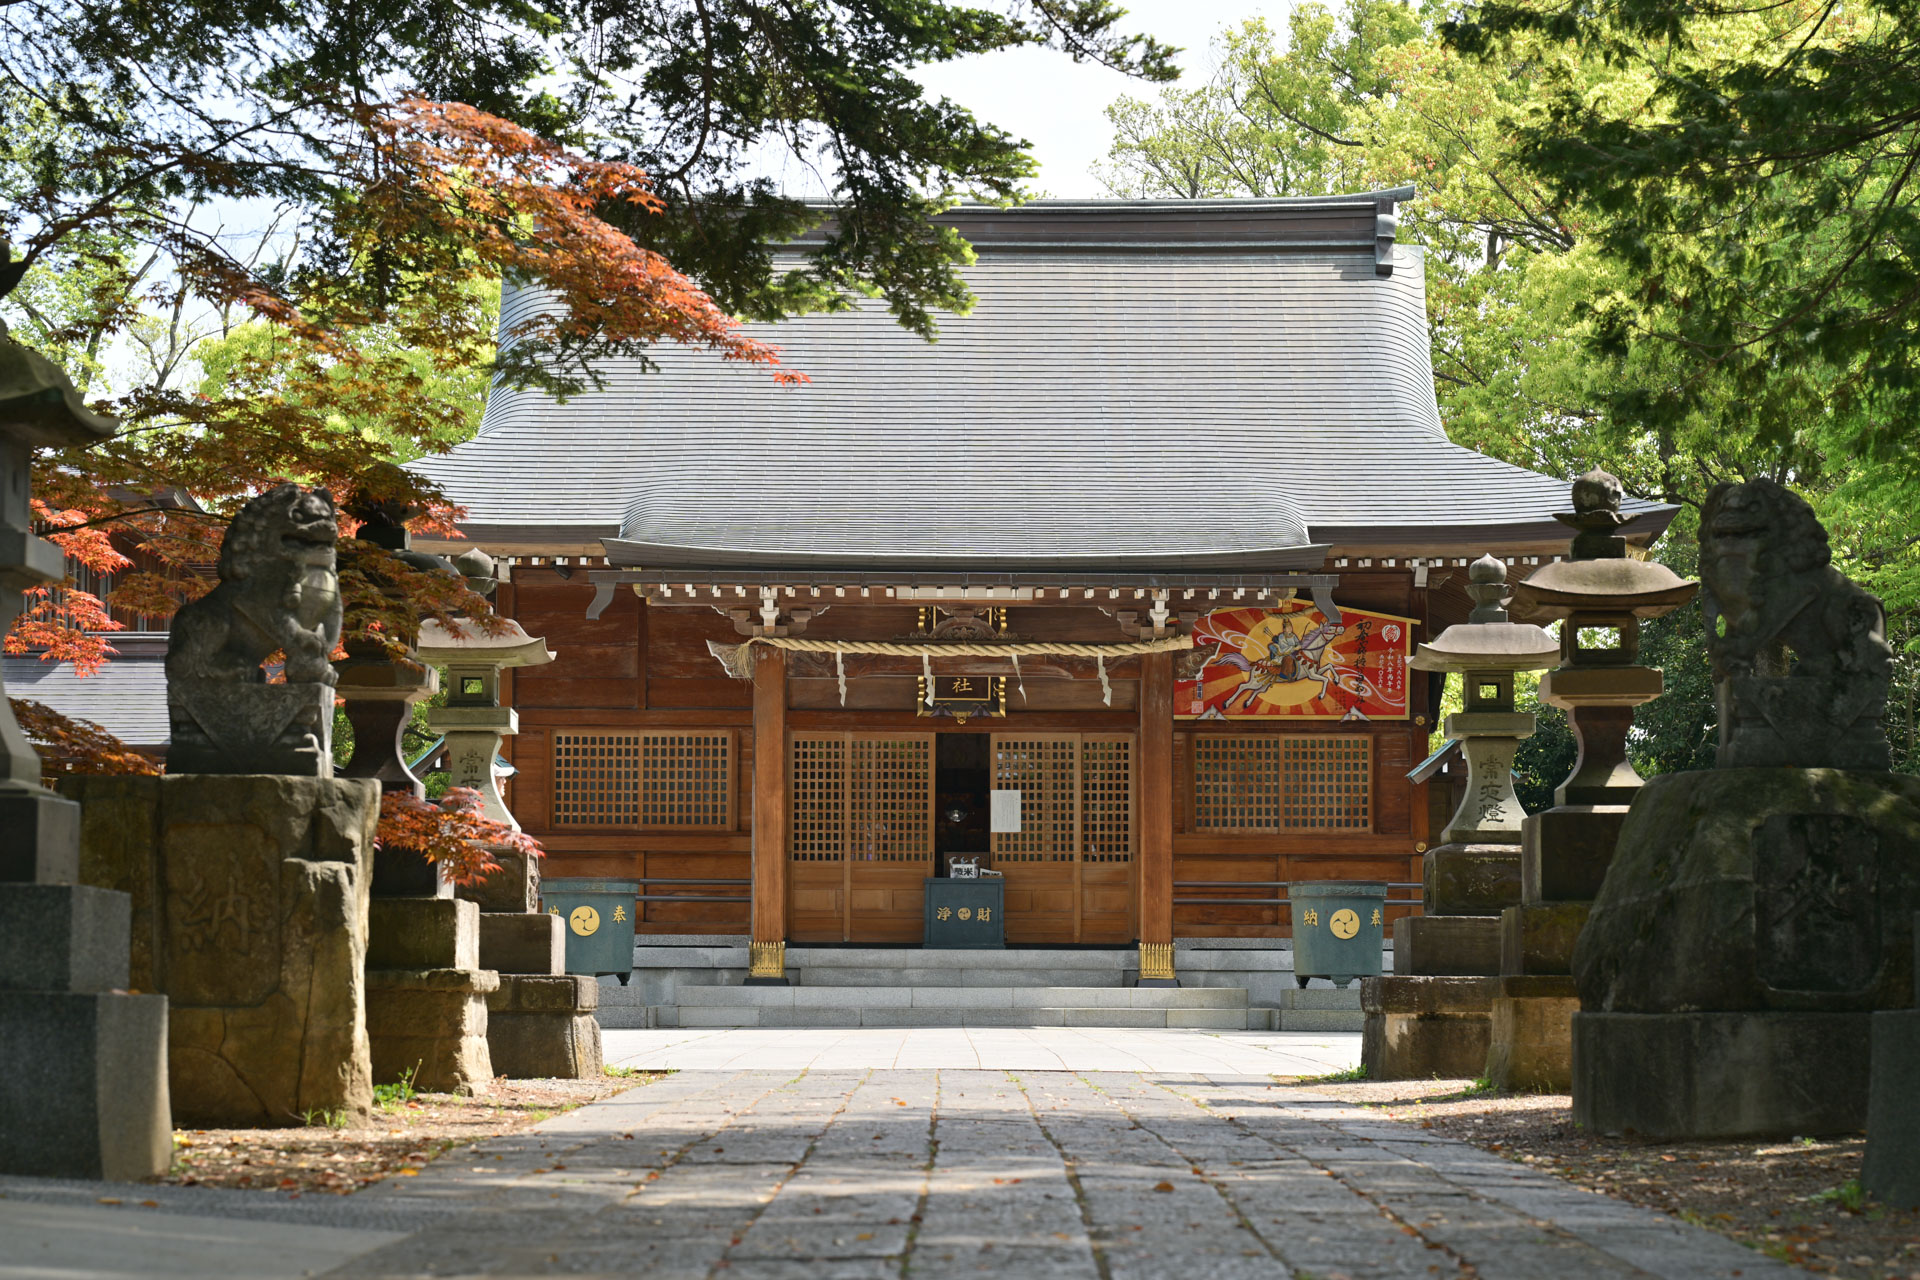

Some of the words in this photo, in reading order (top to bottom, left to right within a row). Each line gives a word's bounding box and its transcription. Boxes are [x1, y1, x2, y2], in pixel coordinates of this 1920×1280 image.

[952, 678, 973, 693] 社
[1476, 754, 1507, 823] 常夜燈
[612, 904, 627, 925] 奉
[936, 906, 952, 922] 浄
[976, 906, 992, 922] 財
[1303, 908, 1318, 928] 納
[1370, 907, 1382, 928] 奉
